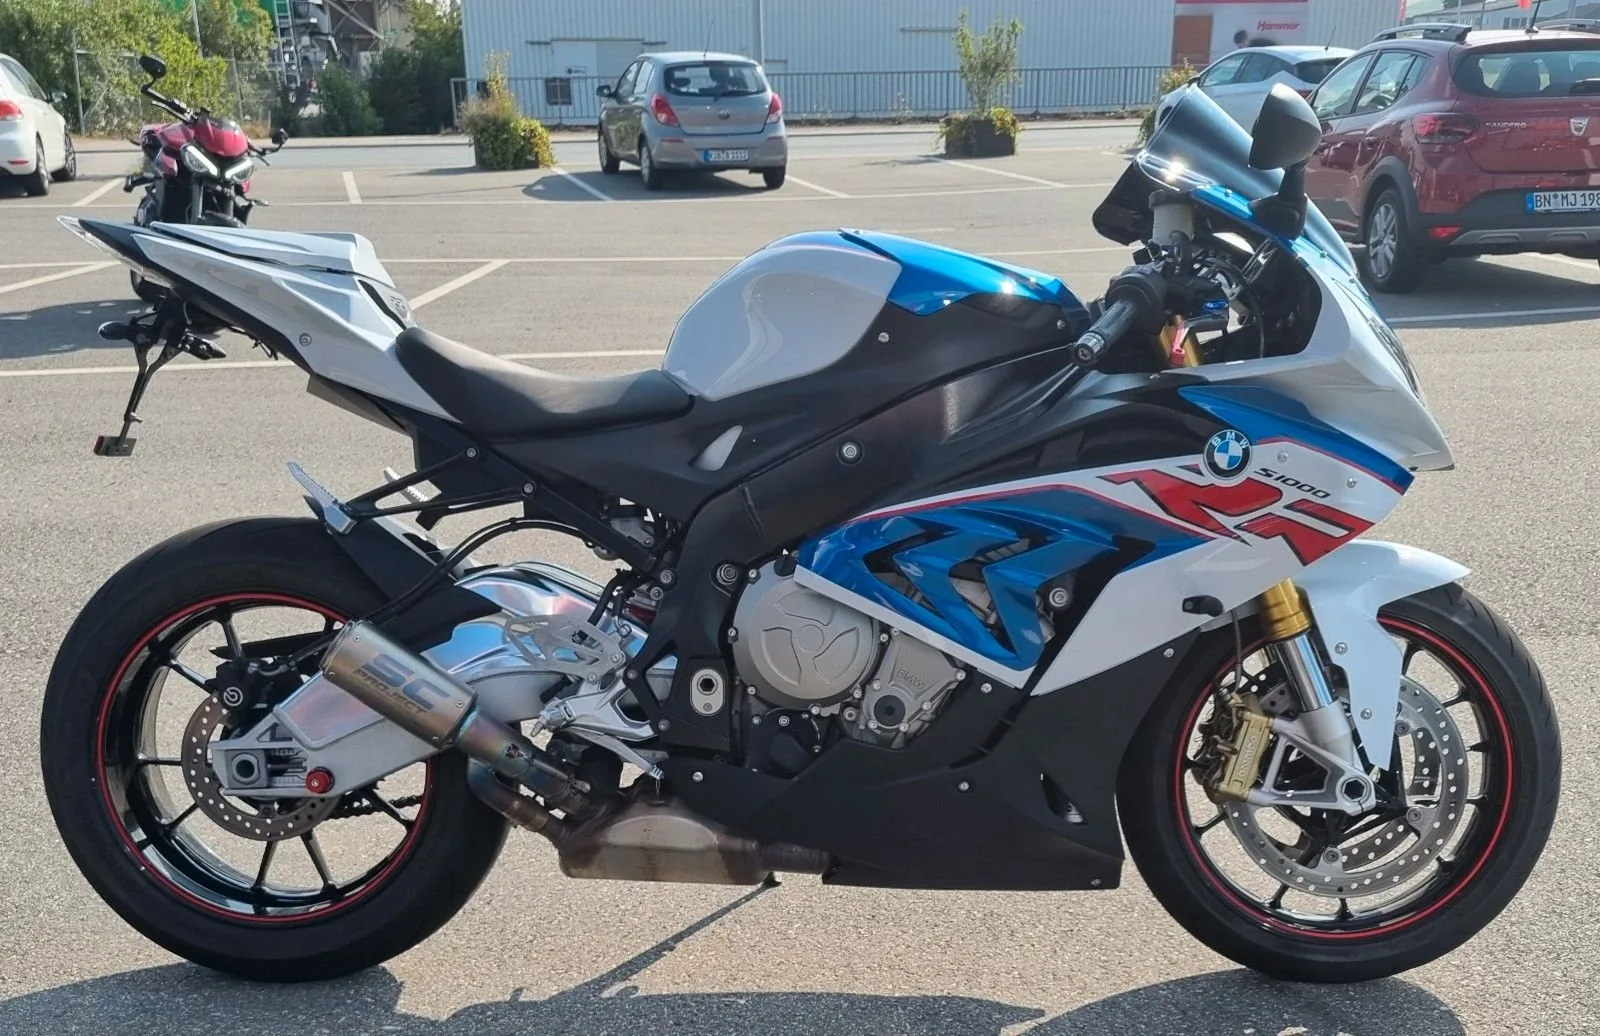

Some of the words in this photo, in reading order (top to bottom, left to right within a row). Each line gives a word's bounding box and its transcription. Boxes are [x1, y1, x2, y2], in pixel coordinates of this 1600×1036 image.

[1535, 194, 1552, 208] BN
[1561, 193, 1577, 207] MJ
[1211, 431, 1249, 449] BMW
[1253, 467, 1331, 500] S1000
[352, 668, 428, 714] PROJECT
[361, 653, 450, 711] SC
